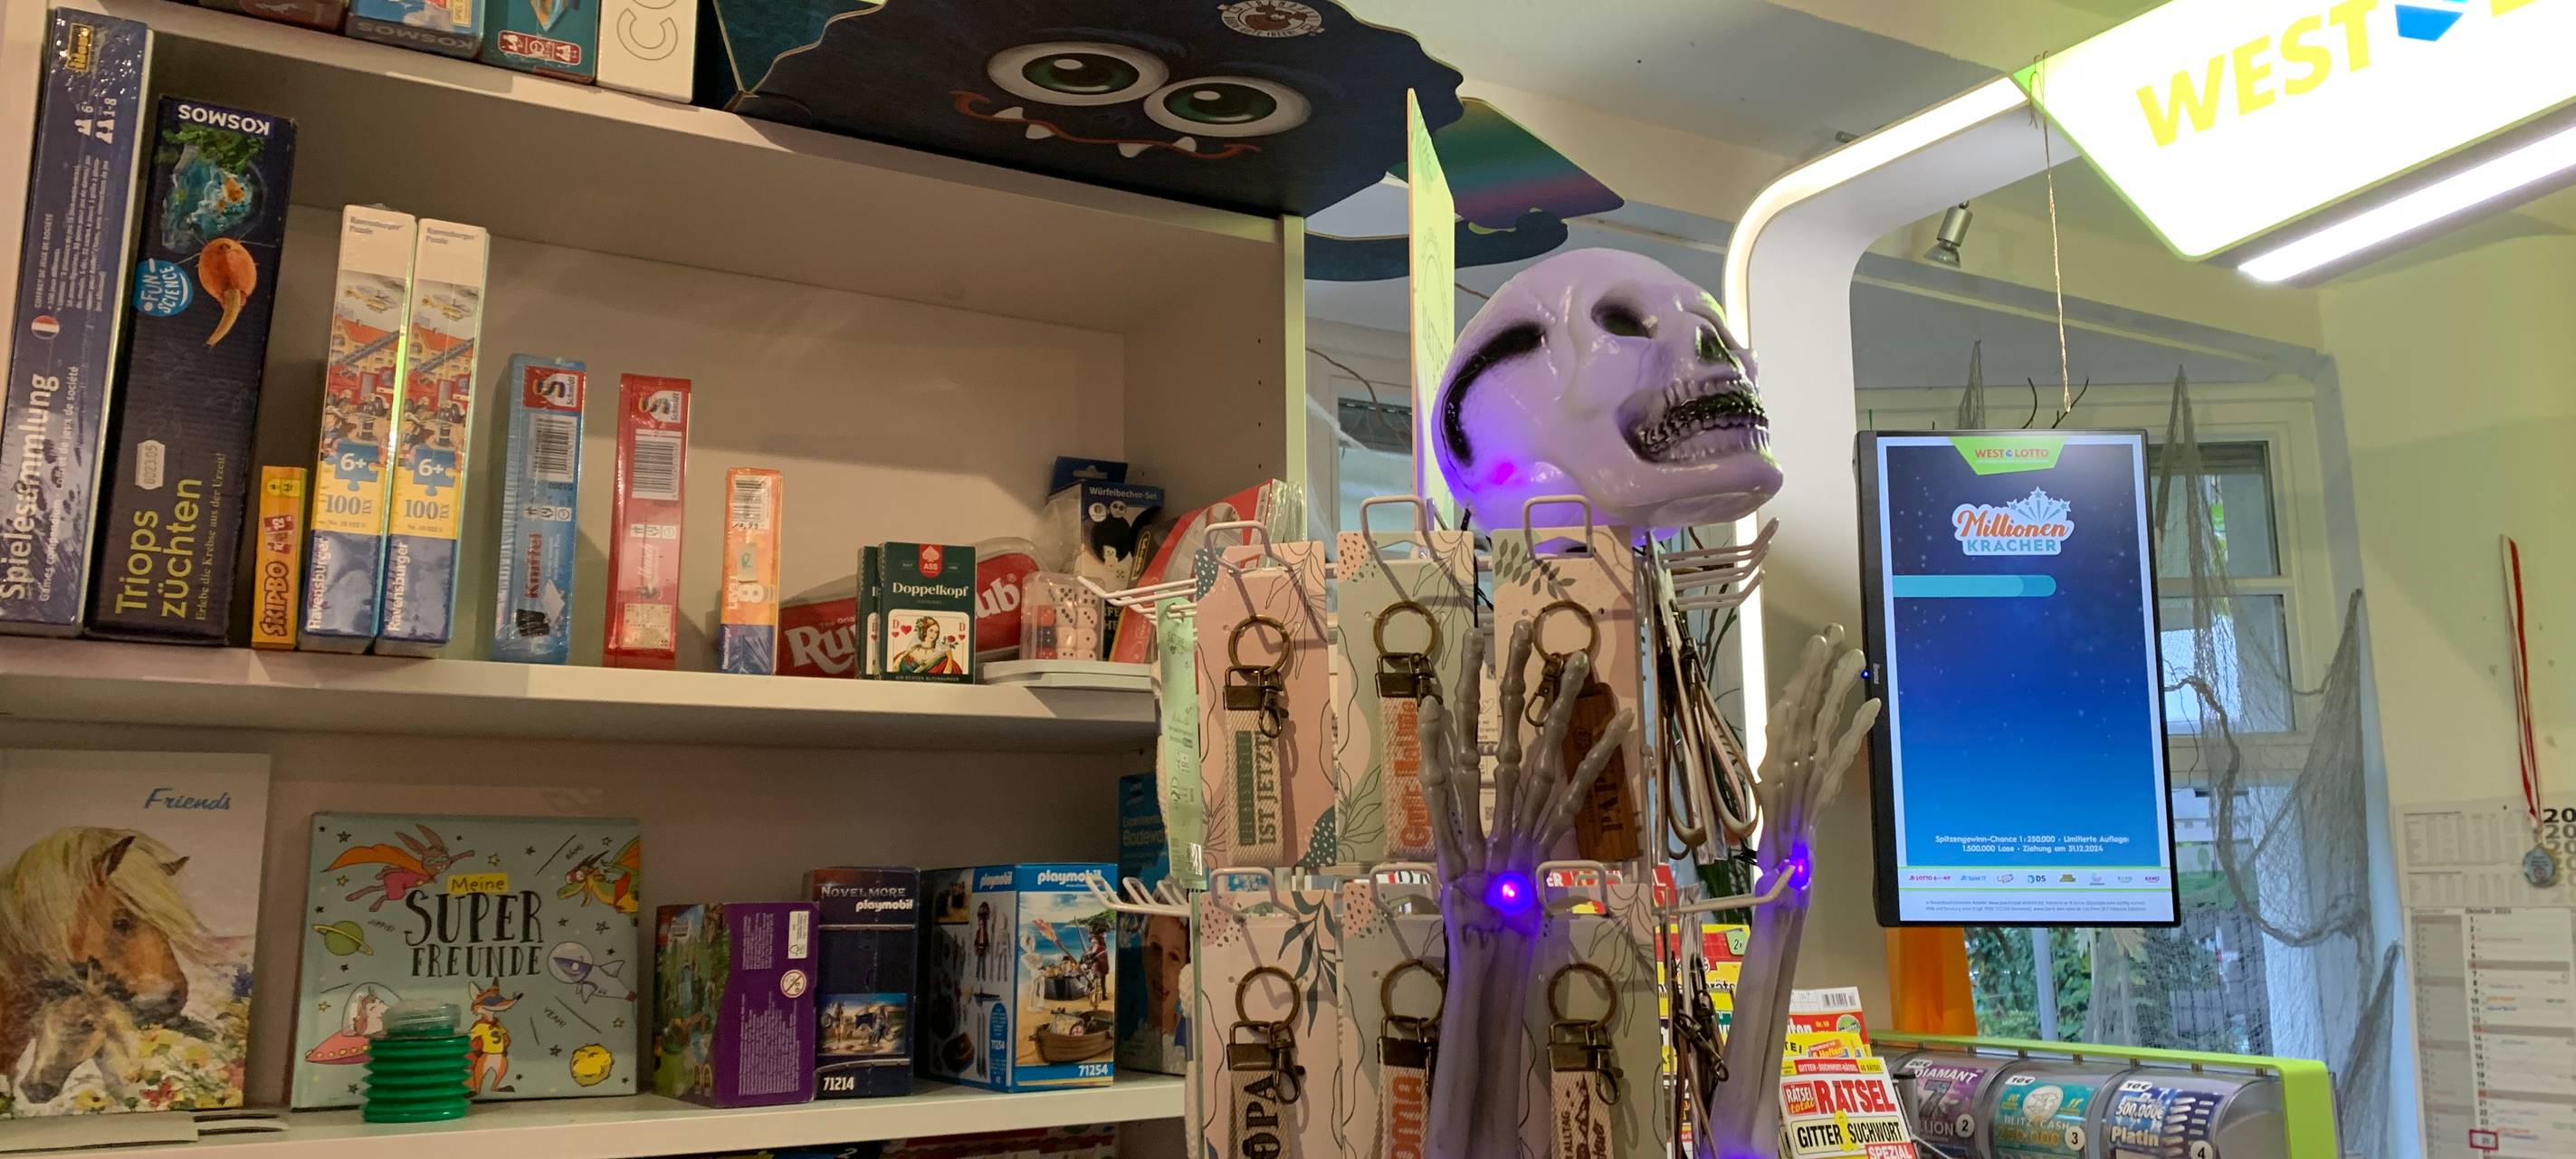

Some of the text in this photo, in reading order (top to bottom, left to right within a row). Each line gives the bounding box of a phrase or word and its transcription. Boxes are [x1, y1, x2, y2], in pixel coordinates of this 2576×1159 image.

[2135, 0, 2380, 148] WEST
[177, 102, 271, 137] KOSMOS
[140, 274, 162, 302] FUN
[157, 265, 180, 314] SCIENCE
[566, 376, 576, 407] Schmidt
[670, 392, 680, 423] Schmidt
[340, 453, 367, 472] 6+
[1974, 448, 2049, 458] WEST LOTTO
[418, 457, 444, 477] 6+
[2, 373, 60, 601] Spielesammlung
[40, 566, 55, 603] Games
[64, 365, 79, 401] société
[1089, 484, 1159, 503] Würfelbecher-Set
[209, 490, 221, 508] der
[325, 493, 361, 515] 100
[211, 510, 219, 527] aus
[404, 499, 439, 521] 100
[1956, 509, 2068, 538] Millionen
[161, 478, 204, 619] züchten
[202, 530, 216, 566] Krebse
[1967, 540, 2056, 552] KRACHER
[114, 509, 161, 615] Triops
[923, 562, 938, 570] ASS
[200, 569, 211, 585] die
[308, 534, 331, 631] Ravensburger
[386, 541, 409, 632] Ravensburger
[892, 581, 969, 599] Doppelkopf
[196, 587, 209, 621] Erlebe
[145, 787, 232, 812] Friends
[2543, 808, 2576, 824] 20
[1257, 809, 1276, 845] IST
[1935, 835, 2017, 846] Spitzengewinn-Chance
[2064, 835, 2097, 844] Limitierte
[1998, 845, 2015, 853] Lose
[2022, 845, 2052, 854] Ziehung
[2068, 844, 2104, 853] 31.12.2024
[452, 875, 505, 893] Meine
[979, 871, 1013, 890] playmobil
[2036, 875, 2046, 883] DS
[821, 886, 907, 899] NOVELMORE
[855, 898, 913, 914] playmobil
[404, 888, 544, 950] SUPER
[411, 943, 541, 979] FREUNDE
[1078, 1062, 1109, 1078] 71254
[1914, 1068, 1979, 1085] DIAMANT
[823, 1076, 854, 1091] 71214
[2010, 1076, 2033, 1085] 10€
[2125, 1081, 2150, 1090] 10€
[1786, 1084, 1814, 1103] RÄTSEL
[1814, 1079, 1898, 1115] RÄTSEL
[1242, 1073, 1281, 1159] OPA
[1789, 1098, 1817, 1115] total
[2115, 1100, 2166, 1121] 500.000€
[1560, 1110, 1573, 1153] ALLTAG
[1961, 1119, 1969, 1132] 2
[2004, 1114, 2070, 1131] BLITZ CASH
[1798, 1121, 1903, 1149] GITTER SUCHWORT
[2071, 1131, 2079, 1145] 3
[2111, 1125, 2160, 1147] Platin
[1867, 1144, 1913, 1159] SPEZIAL
[2197, 1146, 2206, 1159] 4
